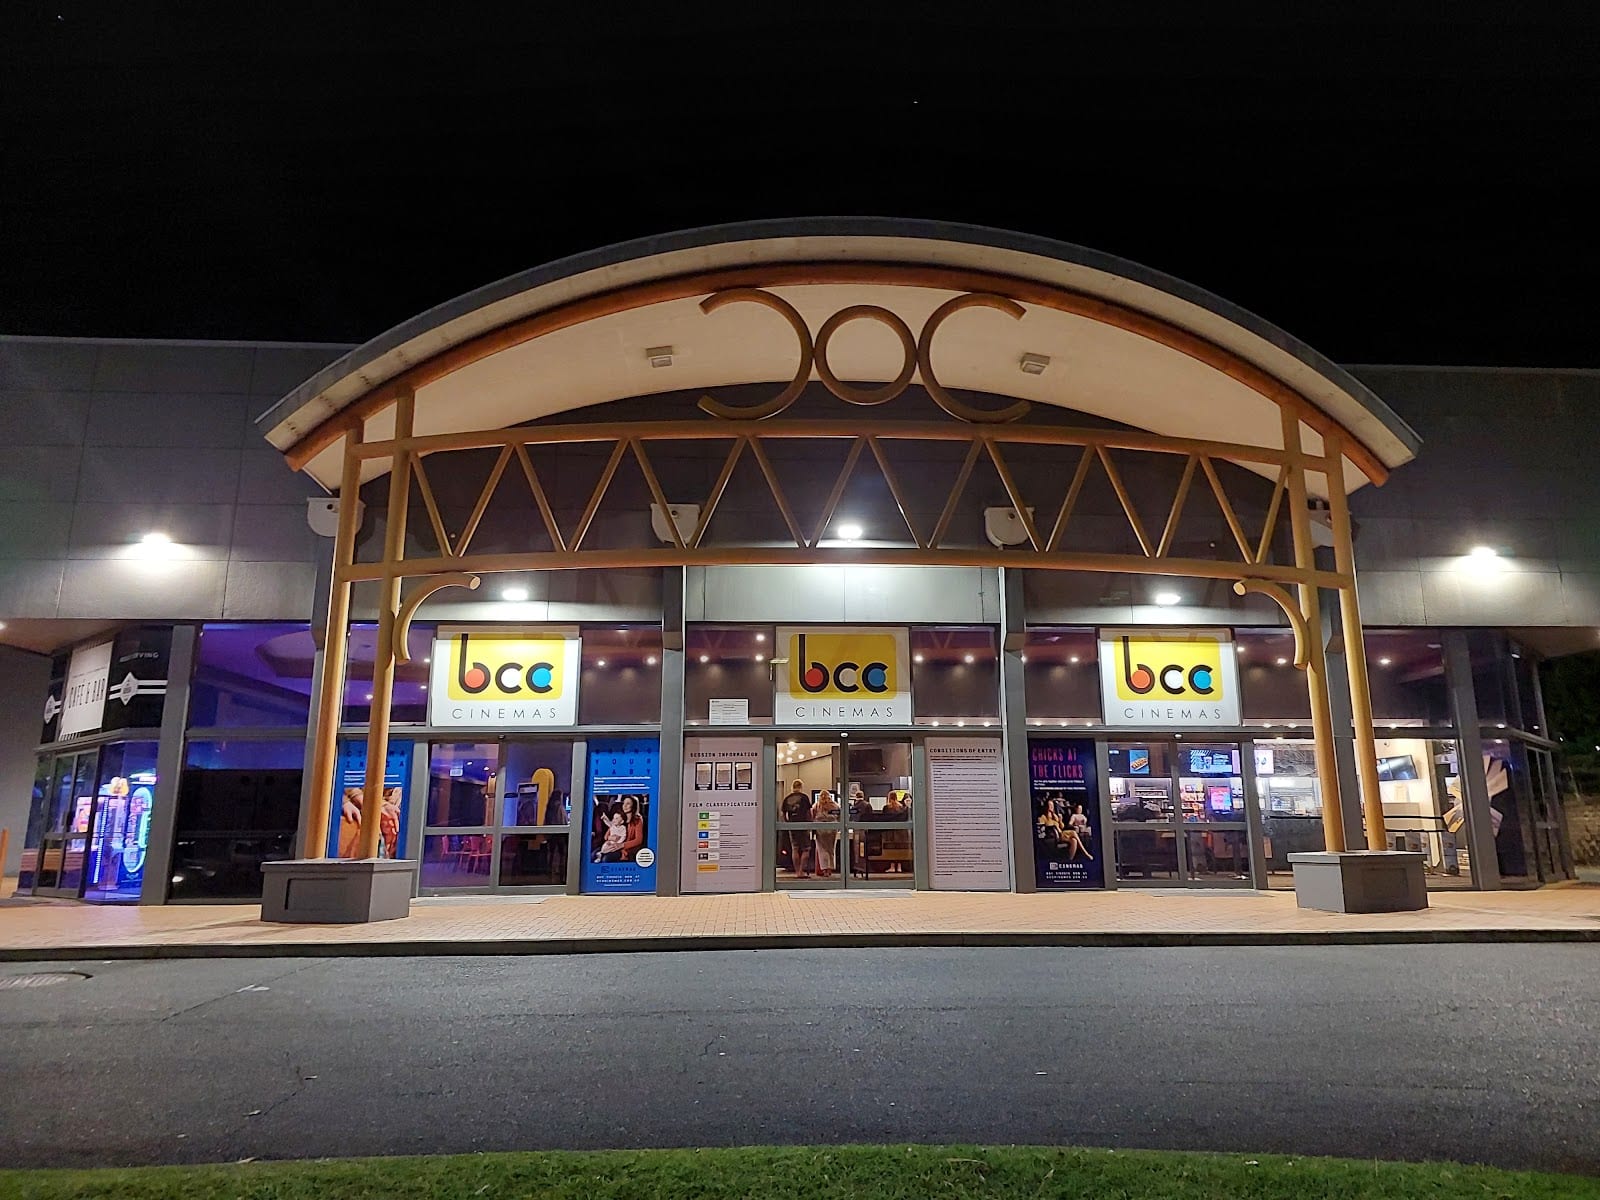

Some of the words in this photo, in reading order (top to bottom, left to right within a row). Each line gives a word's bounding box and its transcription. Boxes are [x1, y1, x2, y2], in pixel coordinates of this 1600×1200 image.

[458, 633, 554, 694] bcc
[798, 633, 889, 693] bcc
[1122, 635, 1215, 695] bcc
[452, 707, 557, 720] CINEMAS
[795, 706, 893, 718] CINEMAS
[1124, 707, 1222, 720] CINEMAS
[1052, 764, 1084, 778] FLICKS
